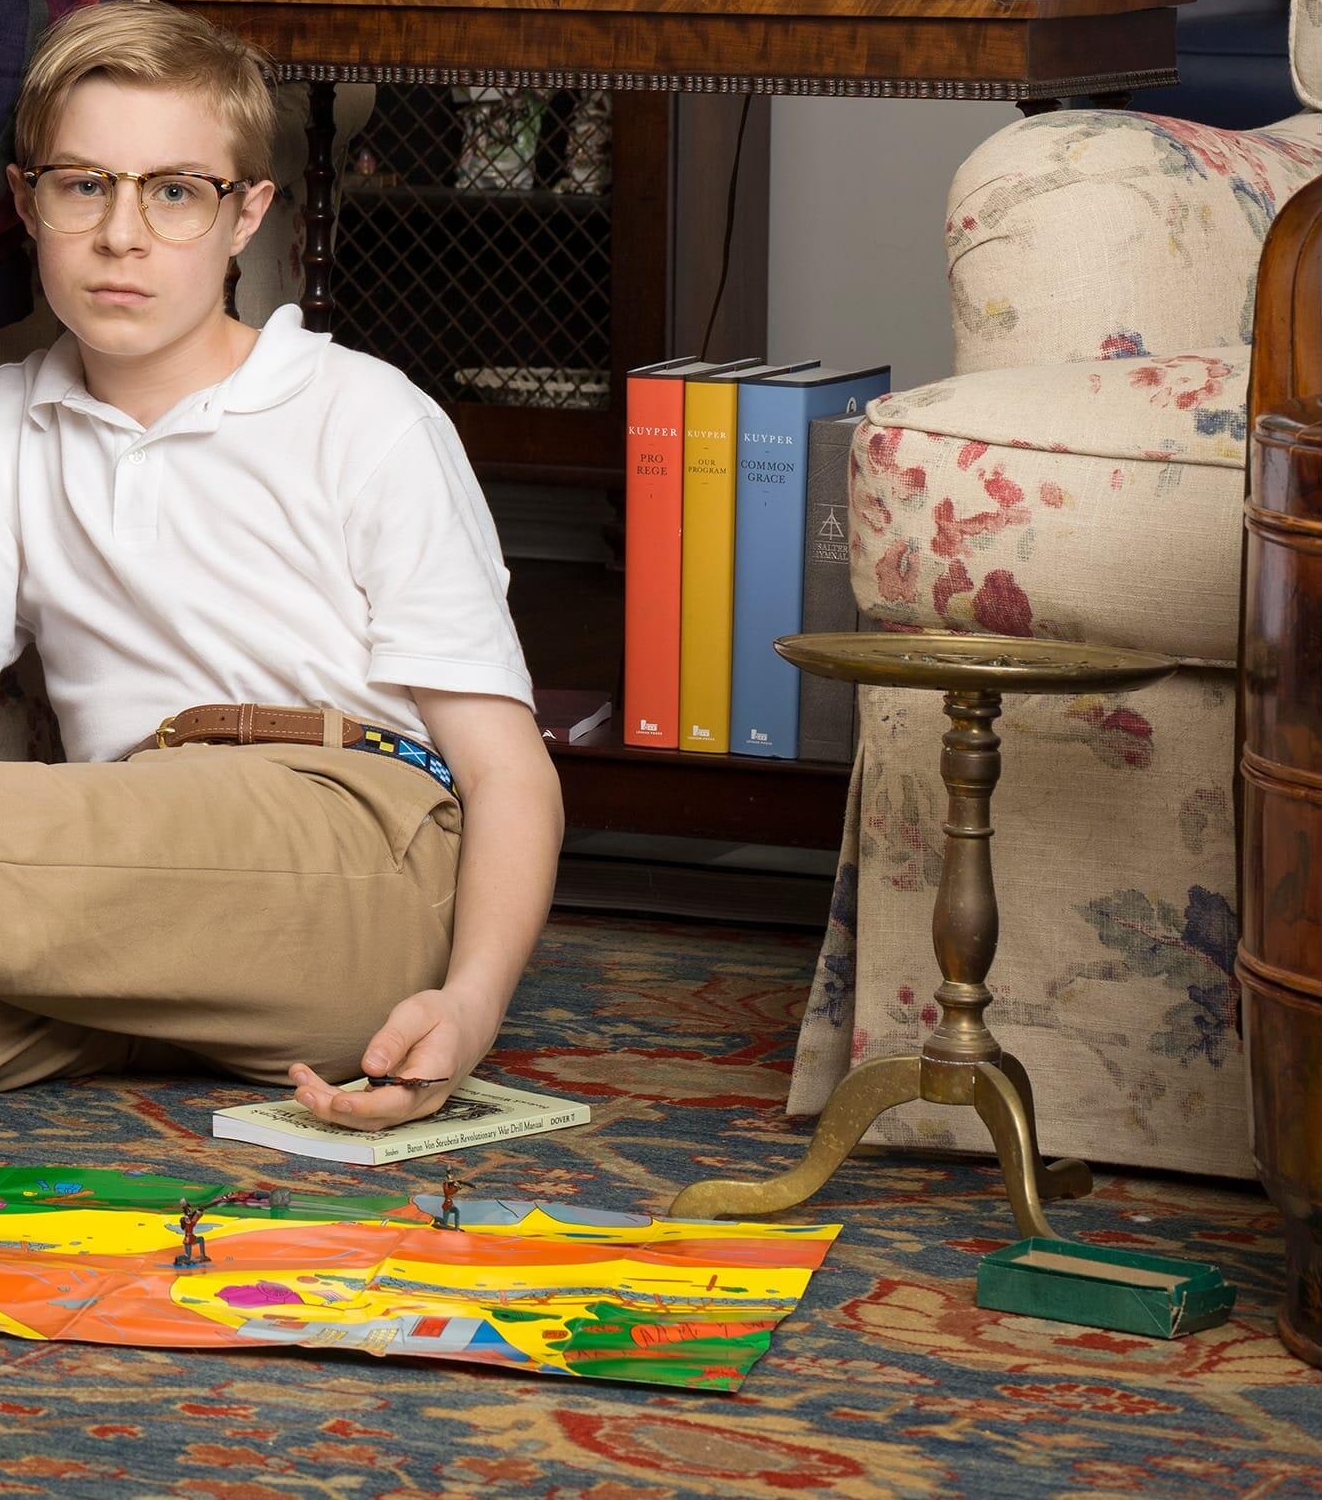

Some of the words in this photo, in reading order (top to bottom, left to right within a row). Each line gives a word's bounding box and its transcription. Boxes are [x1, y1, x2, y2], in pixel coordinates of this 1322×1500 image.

[628, 426, 678, 437] KUYPER
[687, 430, 726, 439] KUYPER
[744, 433, 793, 445] KUYPER
[640, 453, 664, 463] PRO
[636, 465, 668, 476] REGE
[688, 466, 727, 475] PROGRAM
[740, 459, 795, 472] COMMON
[747, 472, 786, 484] GRACE
[407, 1143, 423, 1153] Baron
[460, 1129, 496, 1143] Revolutionary
[498, 1126, 509, 1135] War
[510, 1122, 524, 1134] Drill
[524, 1118, 543, 1132] Manual
[550, 1115, 570, 1126] DOVER
